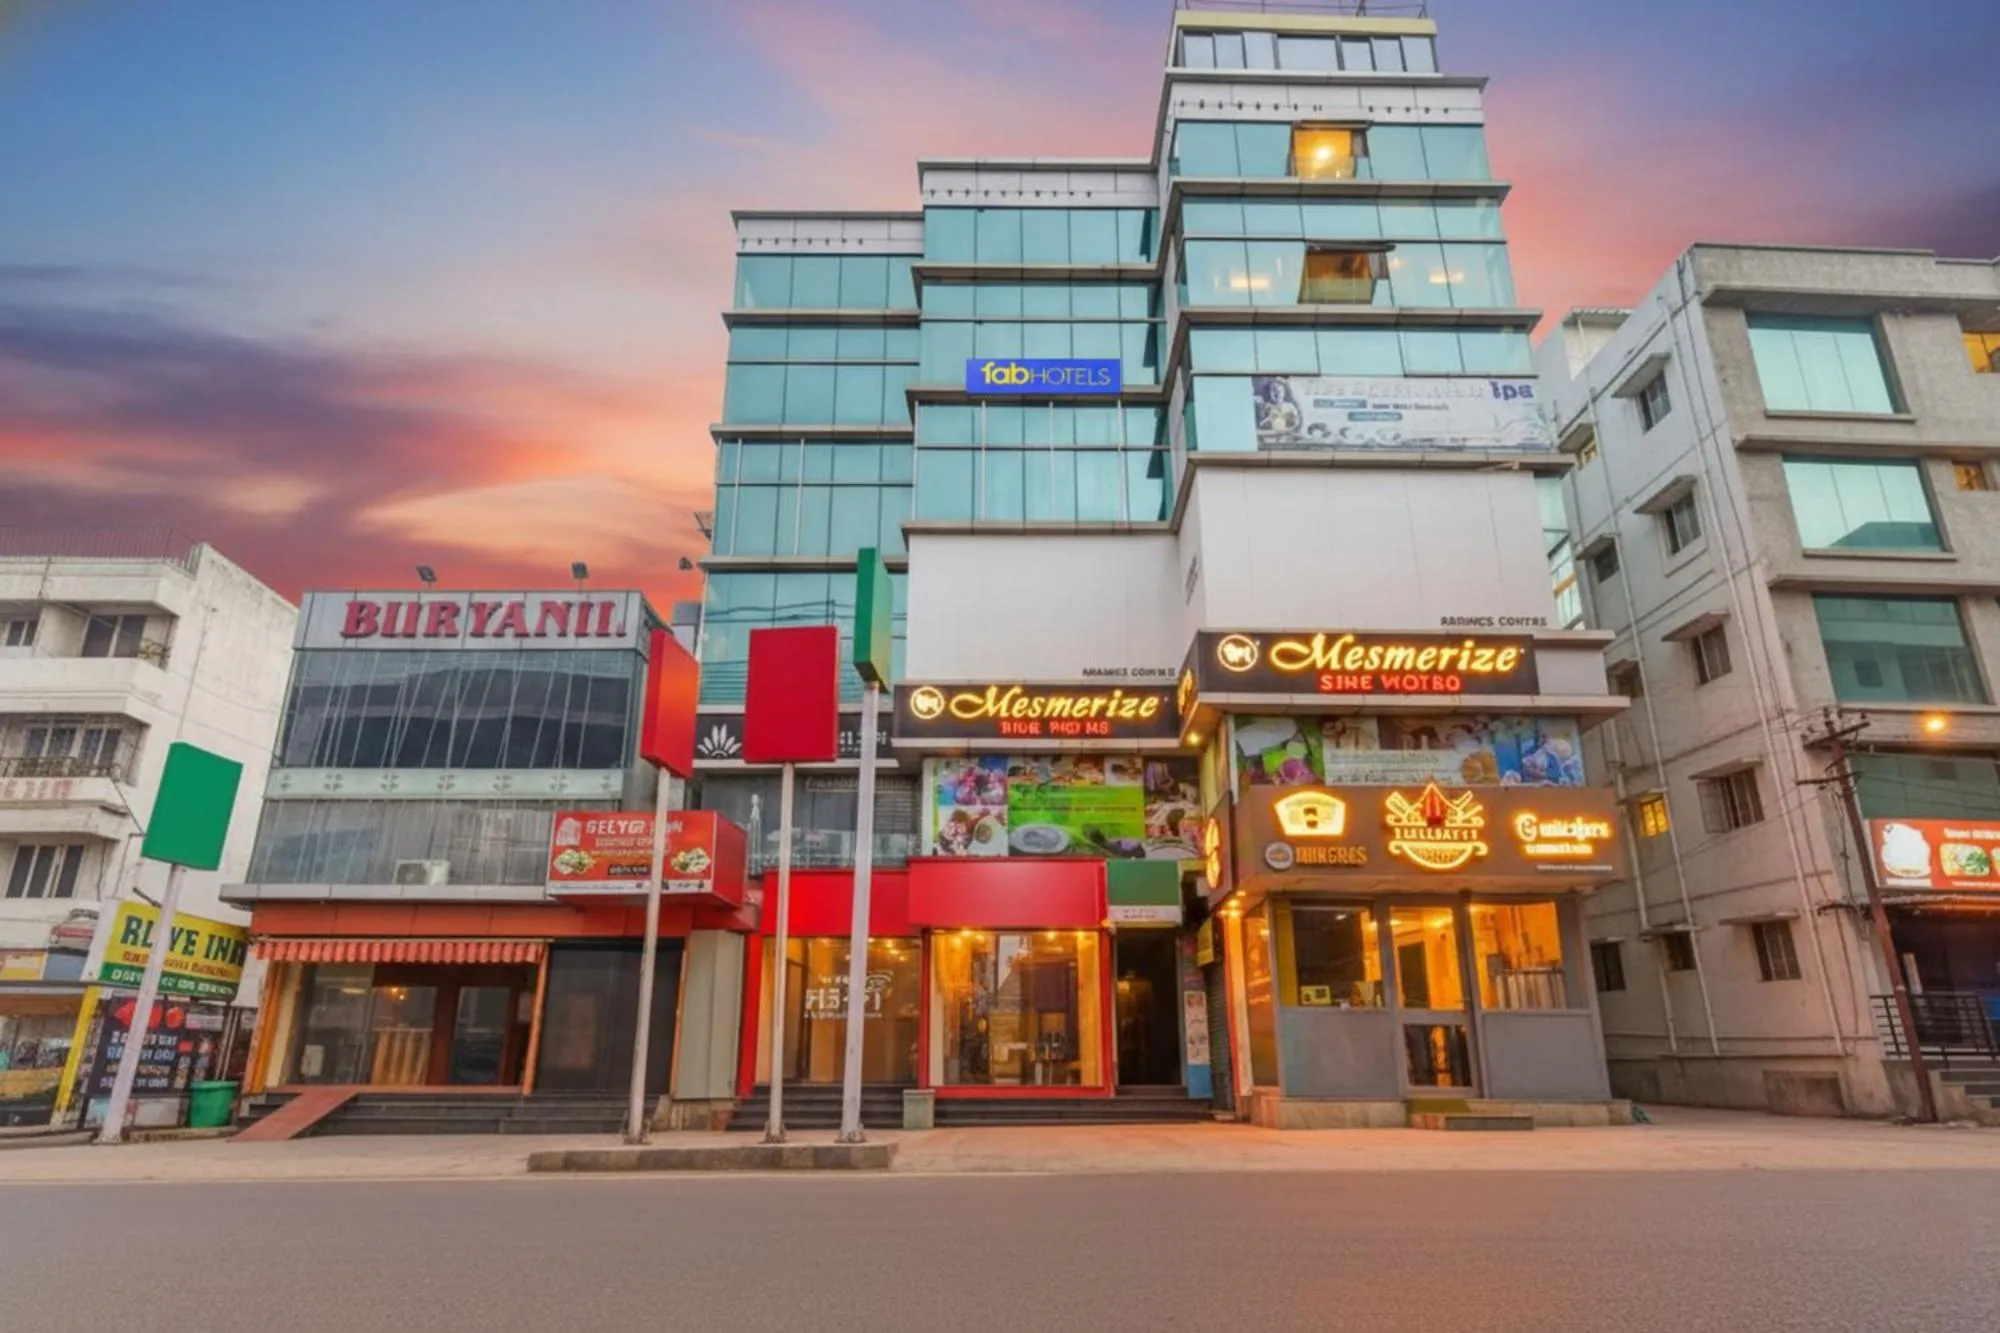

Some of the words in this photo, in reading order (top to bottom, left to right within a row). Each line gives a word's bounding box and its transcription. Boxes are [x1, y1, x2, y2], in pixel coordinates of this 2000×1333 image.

[981, 361, 1112, 386] fabHOTELS
[1269, 632, 1522, 673] Mesmerize
[949, 684, 1160, 719] Mesmerize
